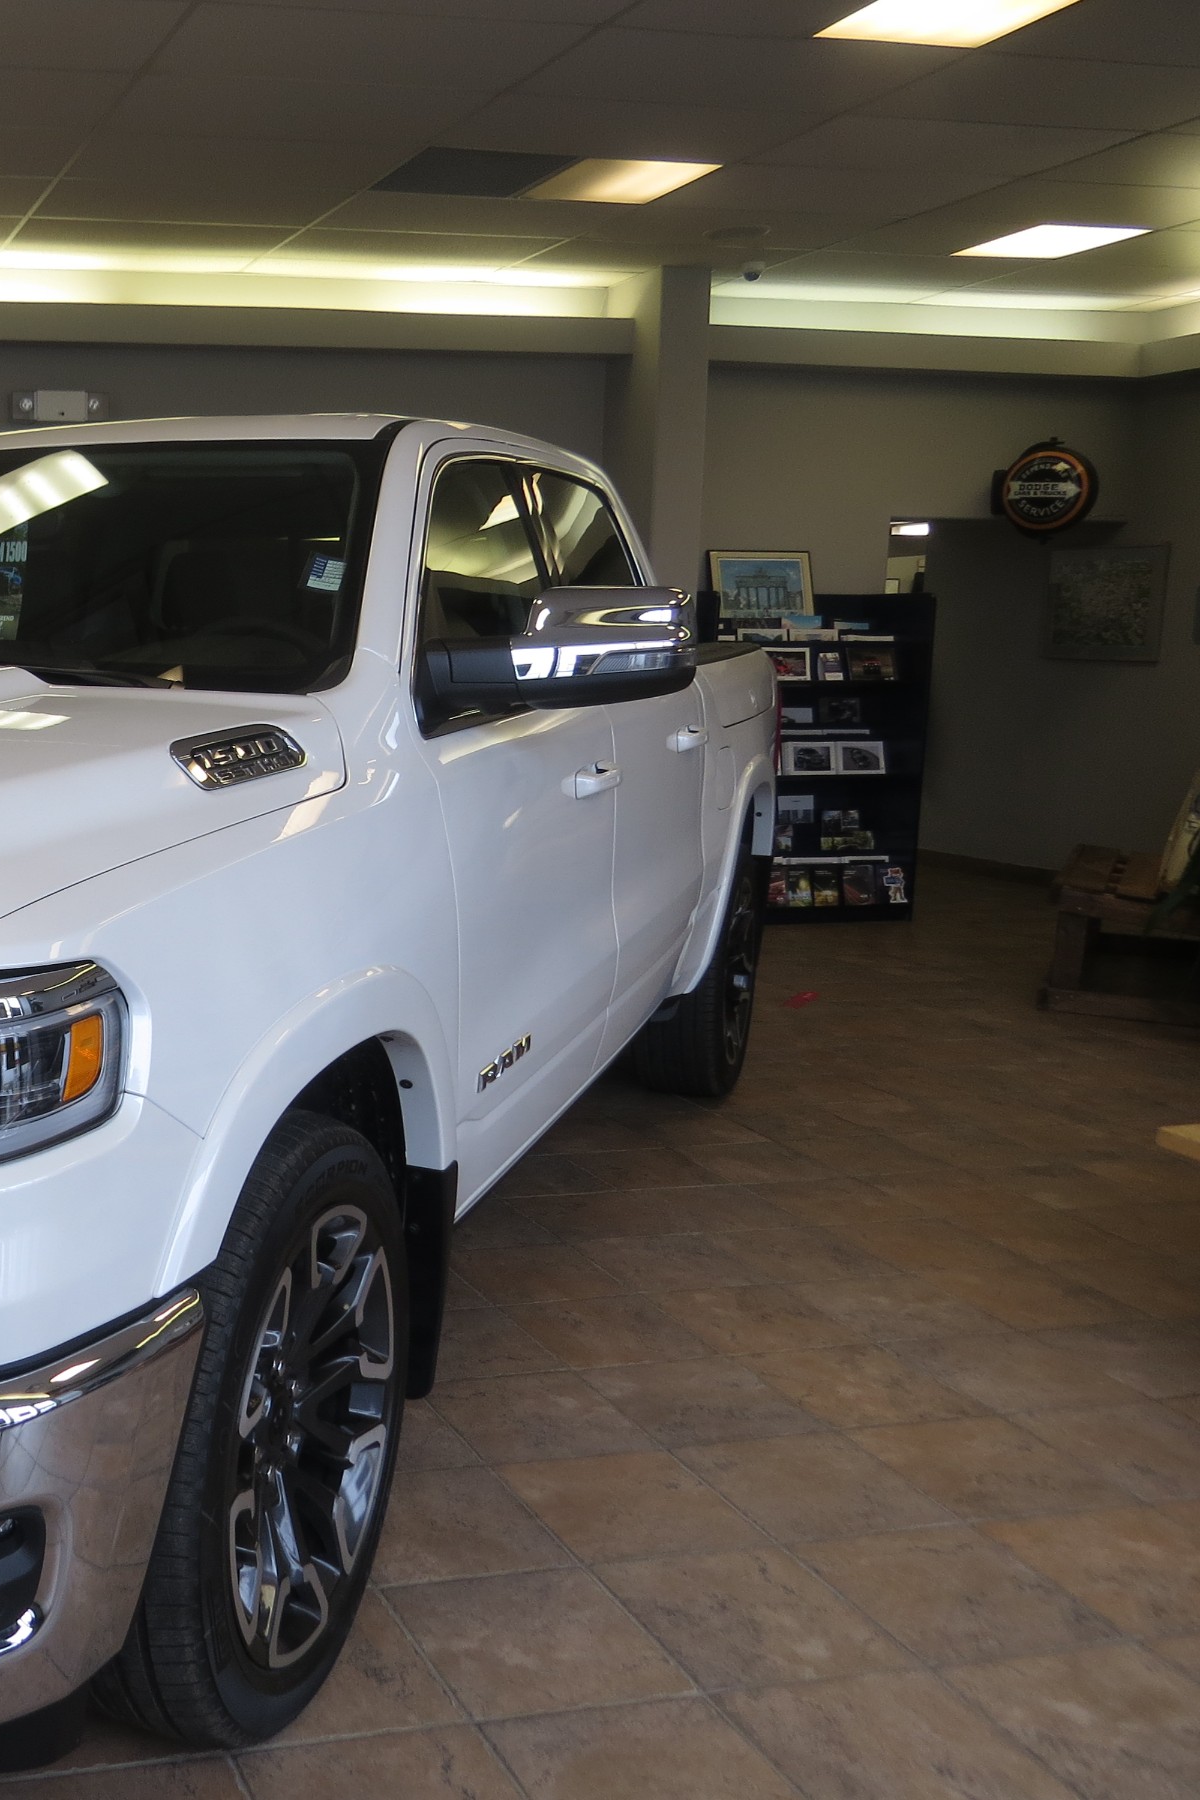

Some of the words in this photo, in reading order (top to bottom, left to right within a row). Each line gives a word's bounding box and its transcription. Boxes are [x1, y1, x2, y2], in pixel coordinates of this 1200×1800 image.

[1020, 462, 1068, 479] DEPENDLE
[1018, 483, 1059, 491] DODGE
[1017, 499, 1066, 517] SERVICE
[5, 540, 28, 563] 1500
[194, 737, 280, 769] 1500
[476, 1032, 532, 1094] RAM
